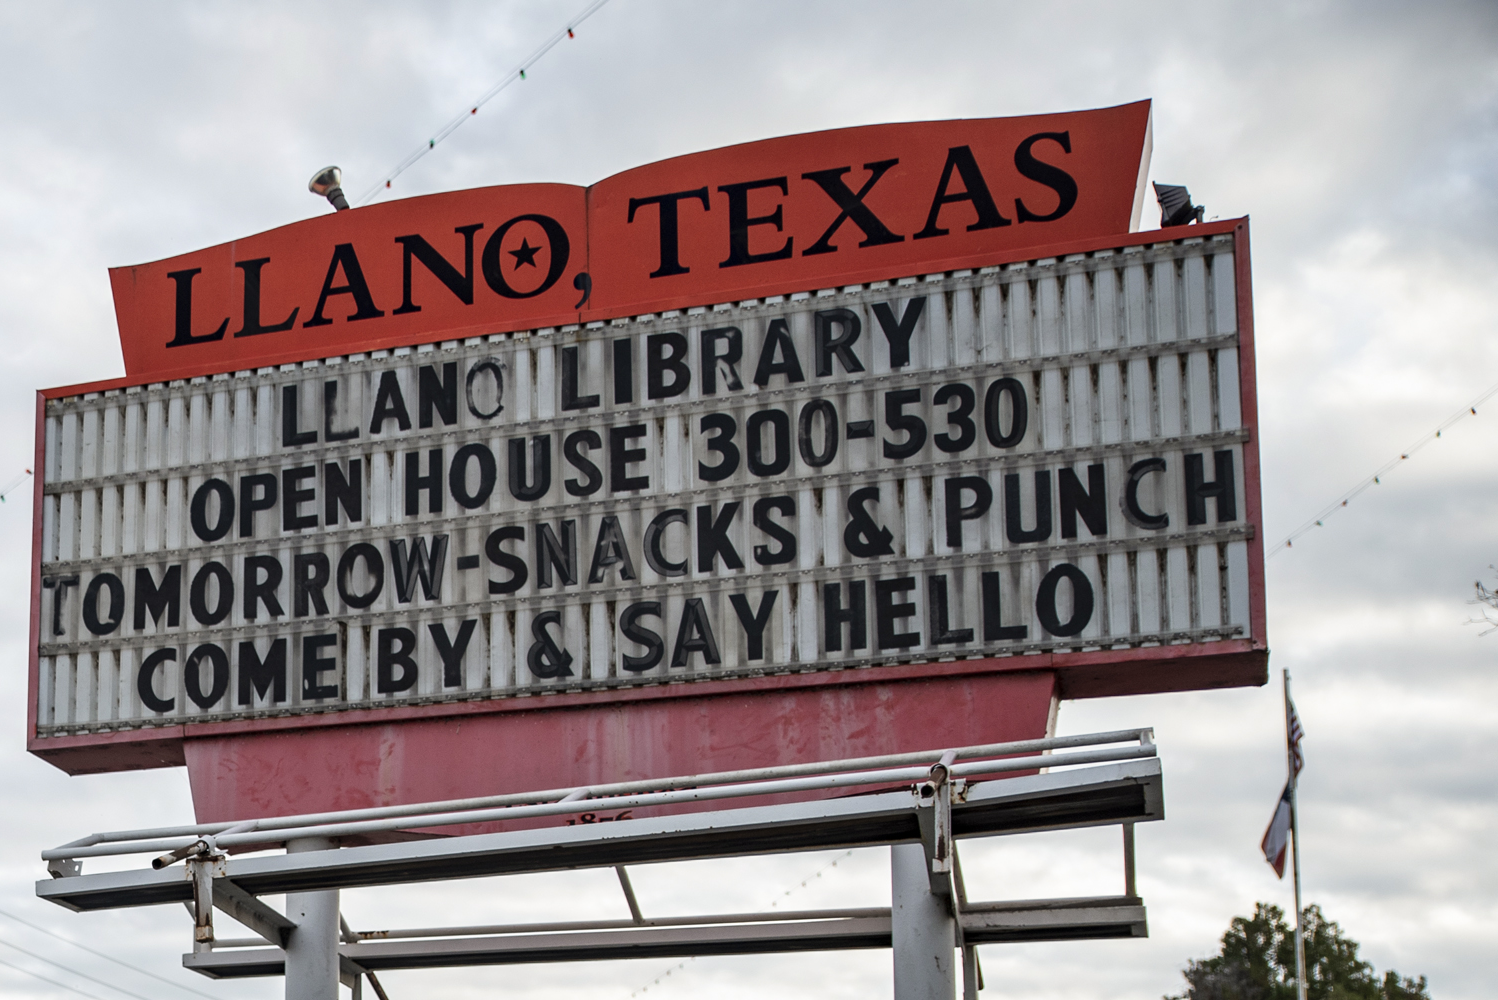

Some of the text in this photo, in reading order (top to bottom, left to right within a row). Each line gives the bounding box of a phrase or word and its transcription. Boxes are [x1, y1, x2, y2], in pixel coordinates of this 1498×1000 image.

[165, 130, 1079, 349] LLANO, TEXAS
[282, 296, 927, 448] LLANO LIBRARY
[189, 377, 1029, 542] OPEN HOUSE 300-530
[43, 449, 1237, 637] TOMORROW-SNACKS & PUNCH
[136, 562, 1095, 713] COME BY & SAY HELLO
